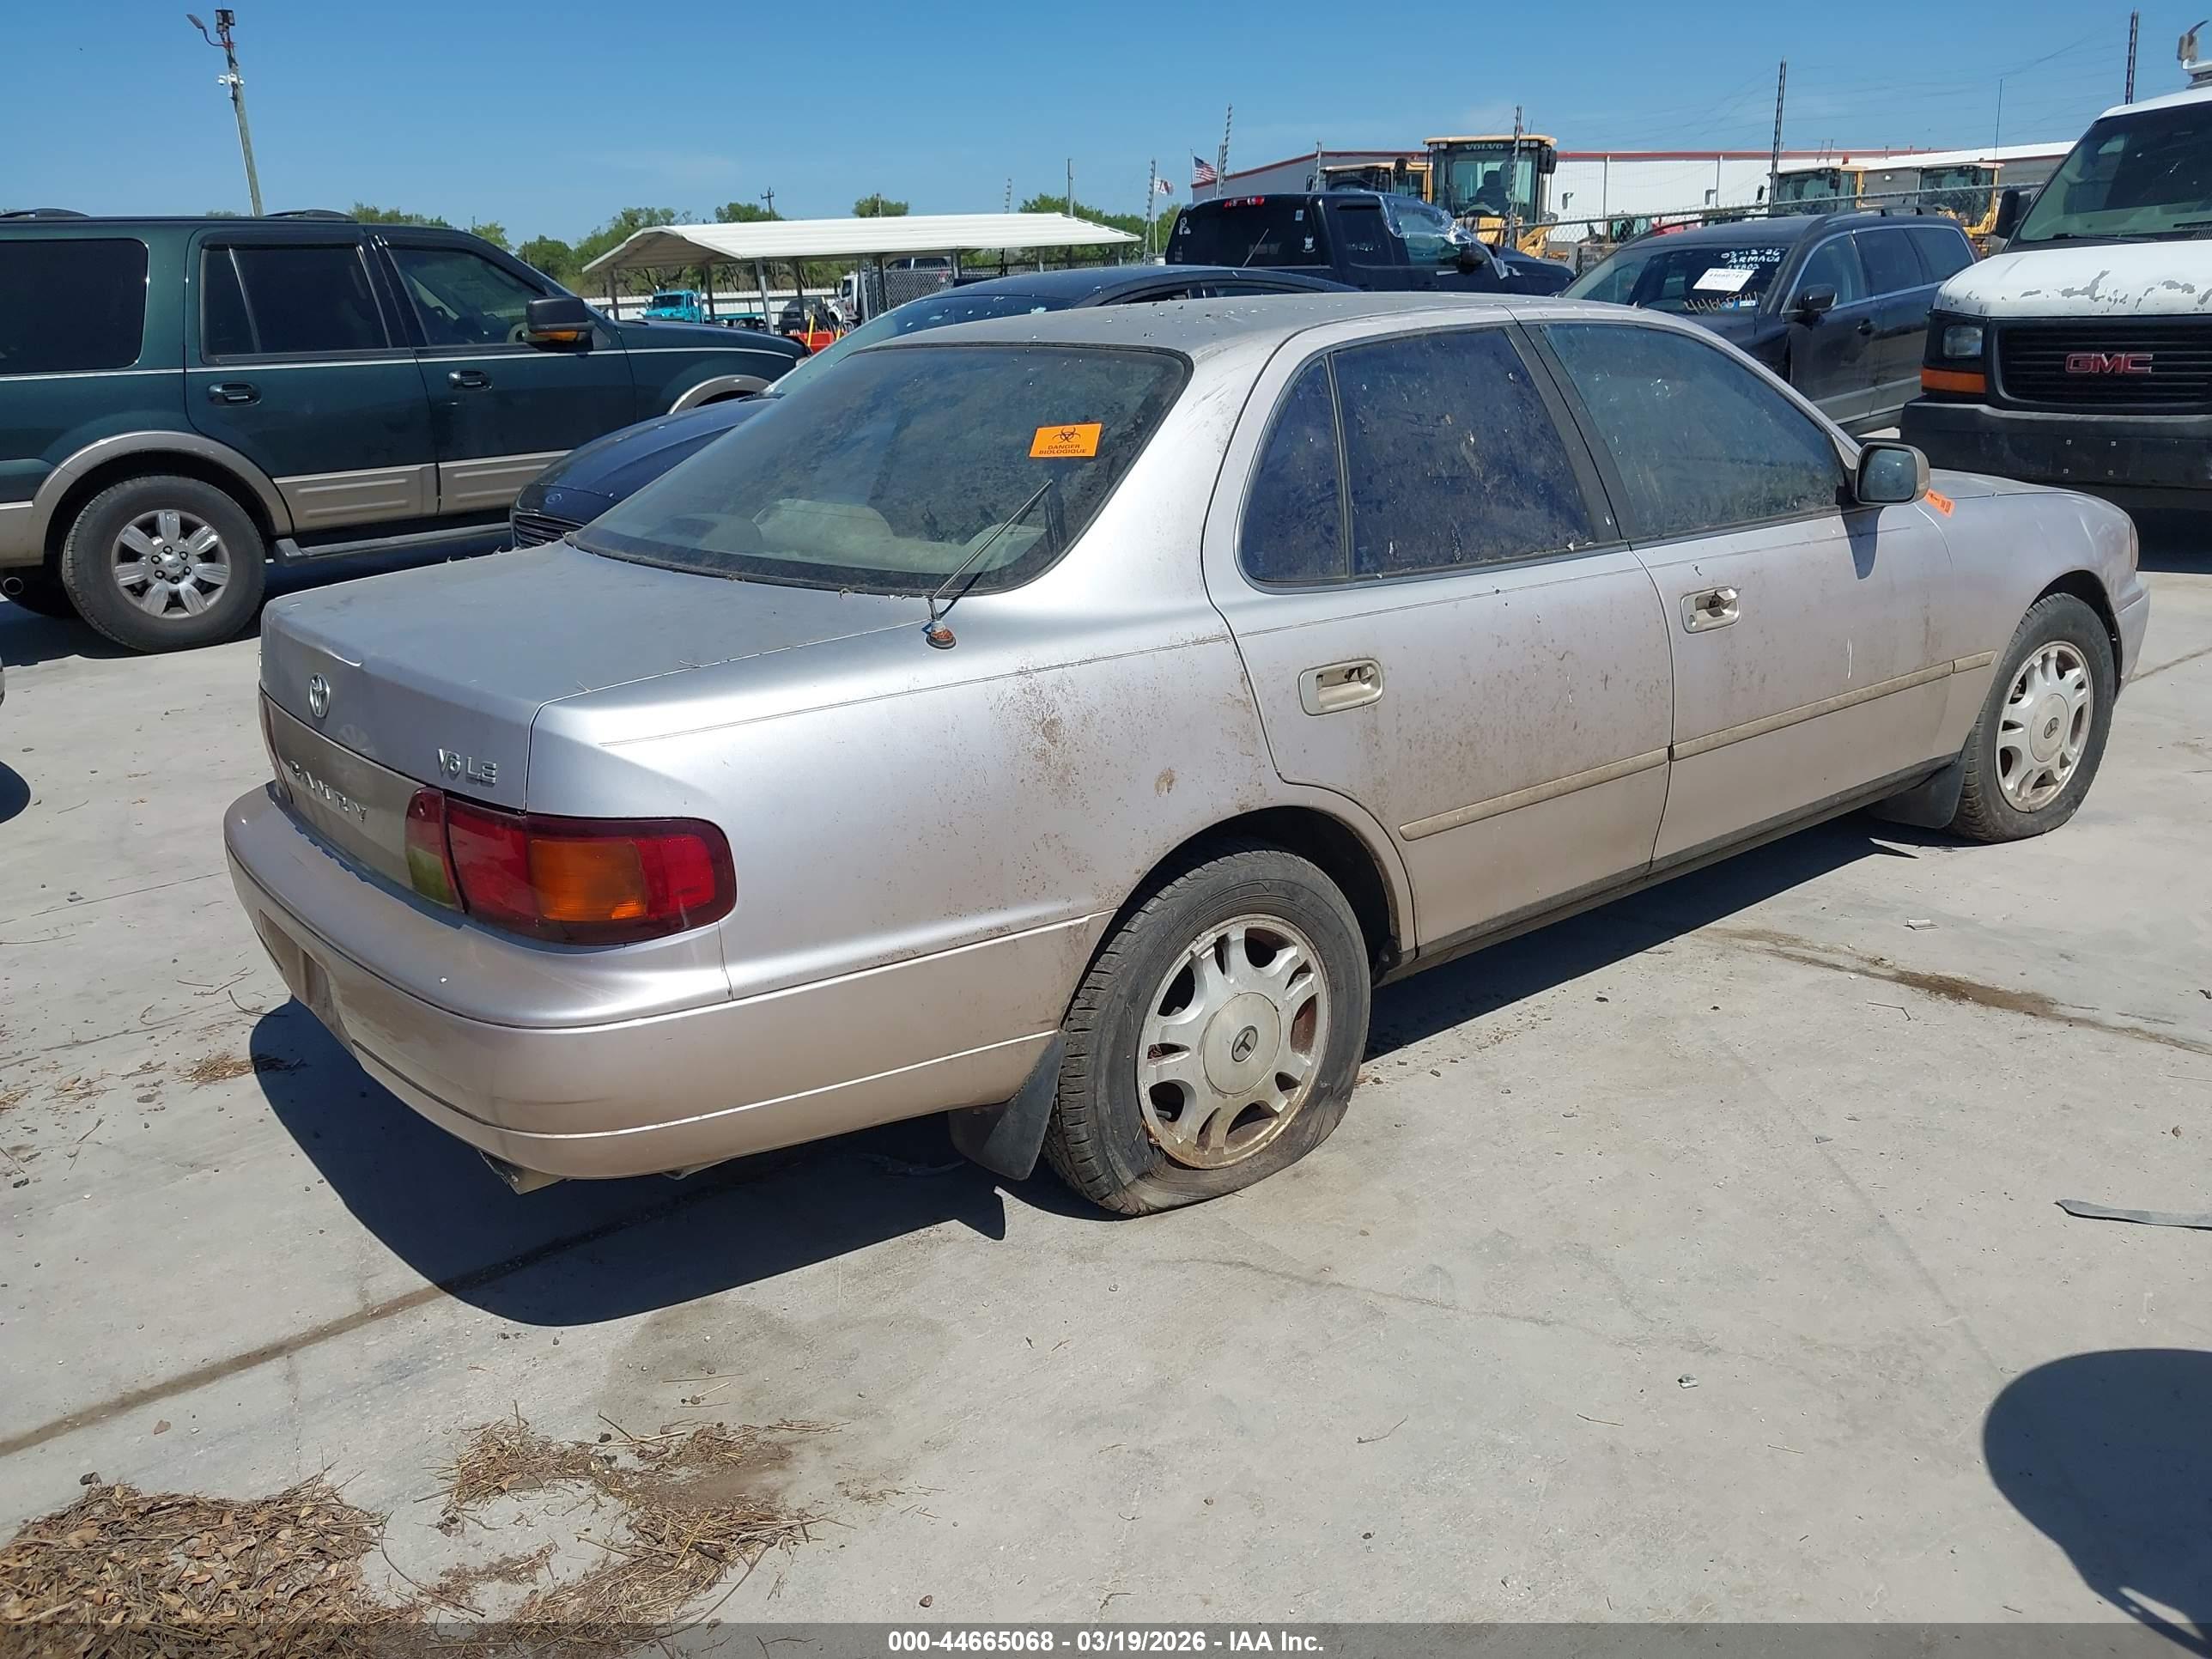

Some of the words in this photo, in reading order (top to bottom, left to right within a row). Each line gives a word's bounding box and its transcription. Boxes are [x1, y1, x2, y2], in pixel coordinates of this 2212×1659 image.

[2065, 353, 2154, 374] GMC
[436, 748, 461, 773] V6
[467, 757, 497, 784] LE
[289, 759, 368, 823] CAMRY
